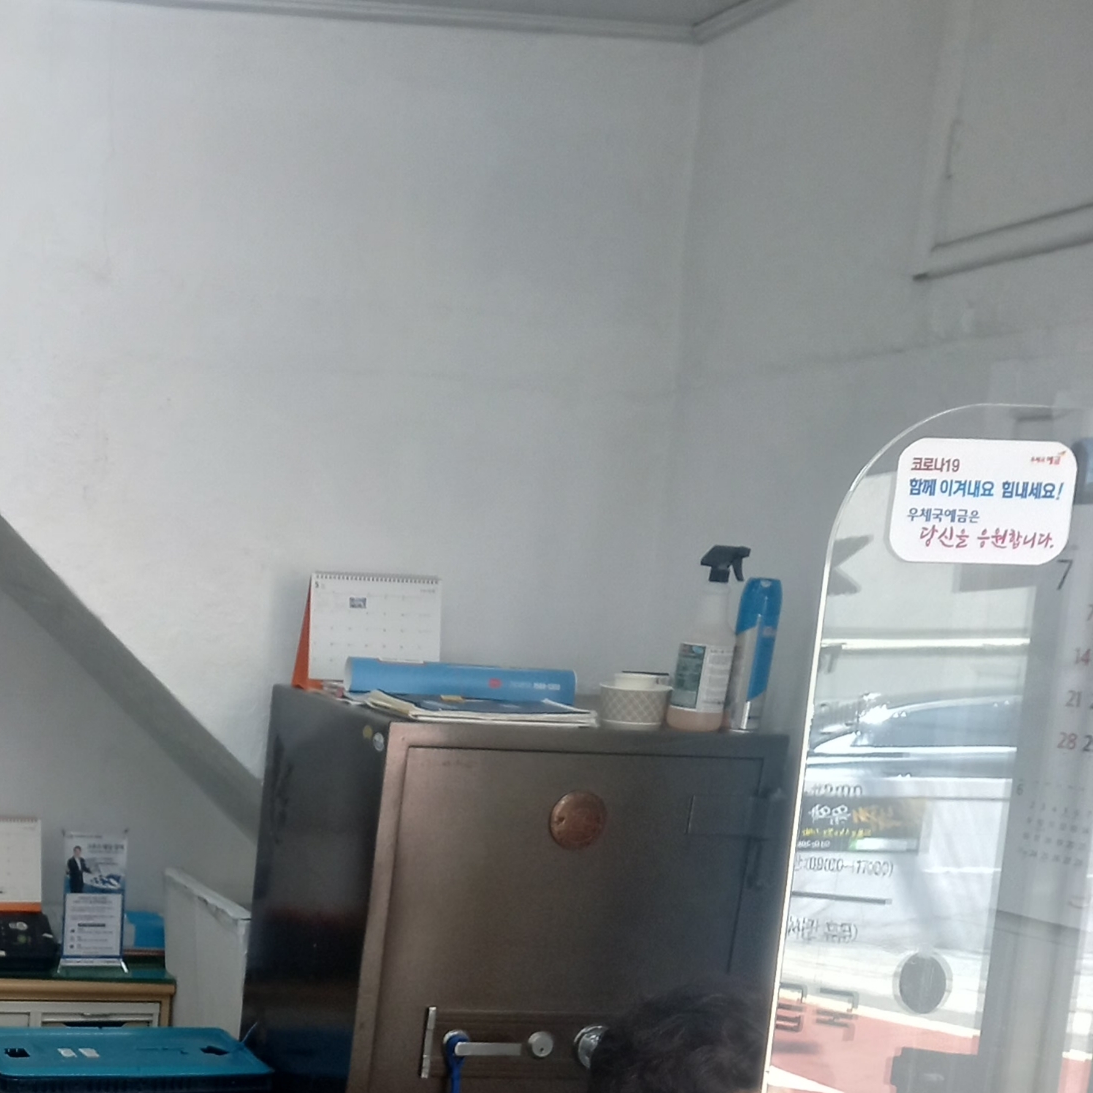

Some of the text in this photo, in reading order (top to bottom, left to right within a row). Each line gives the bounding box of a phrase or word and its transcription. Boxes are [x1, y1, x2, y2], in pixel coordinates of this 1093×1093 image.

[910, 456, 961, 473] 코로나19
[909, 478, 1065, 500] 함께 이겨내요 힘내세요!
[907, 507, 980, 523] 우체국예금은
[919, 525, 1055, 549] 당신을 응원합니다.
[1057, 559, 1073, 590] 7
[1075, 648, 1091, 666] 14
[1065, 690, 1083, 708] 21
[1057, 732, 1078, 750] 28
